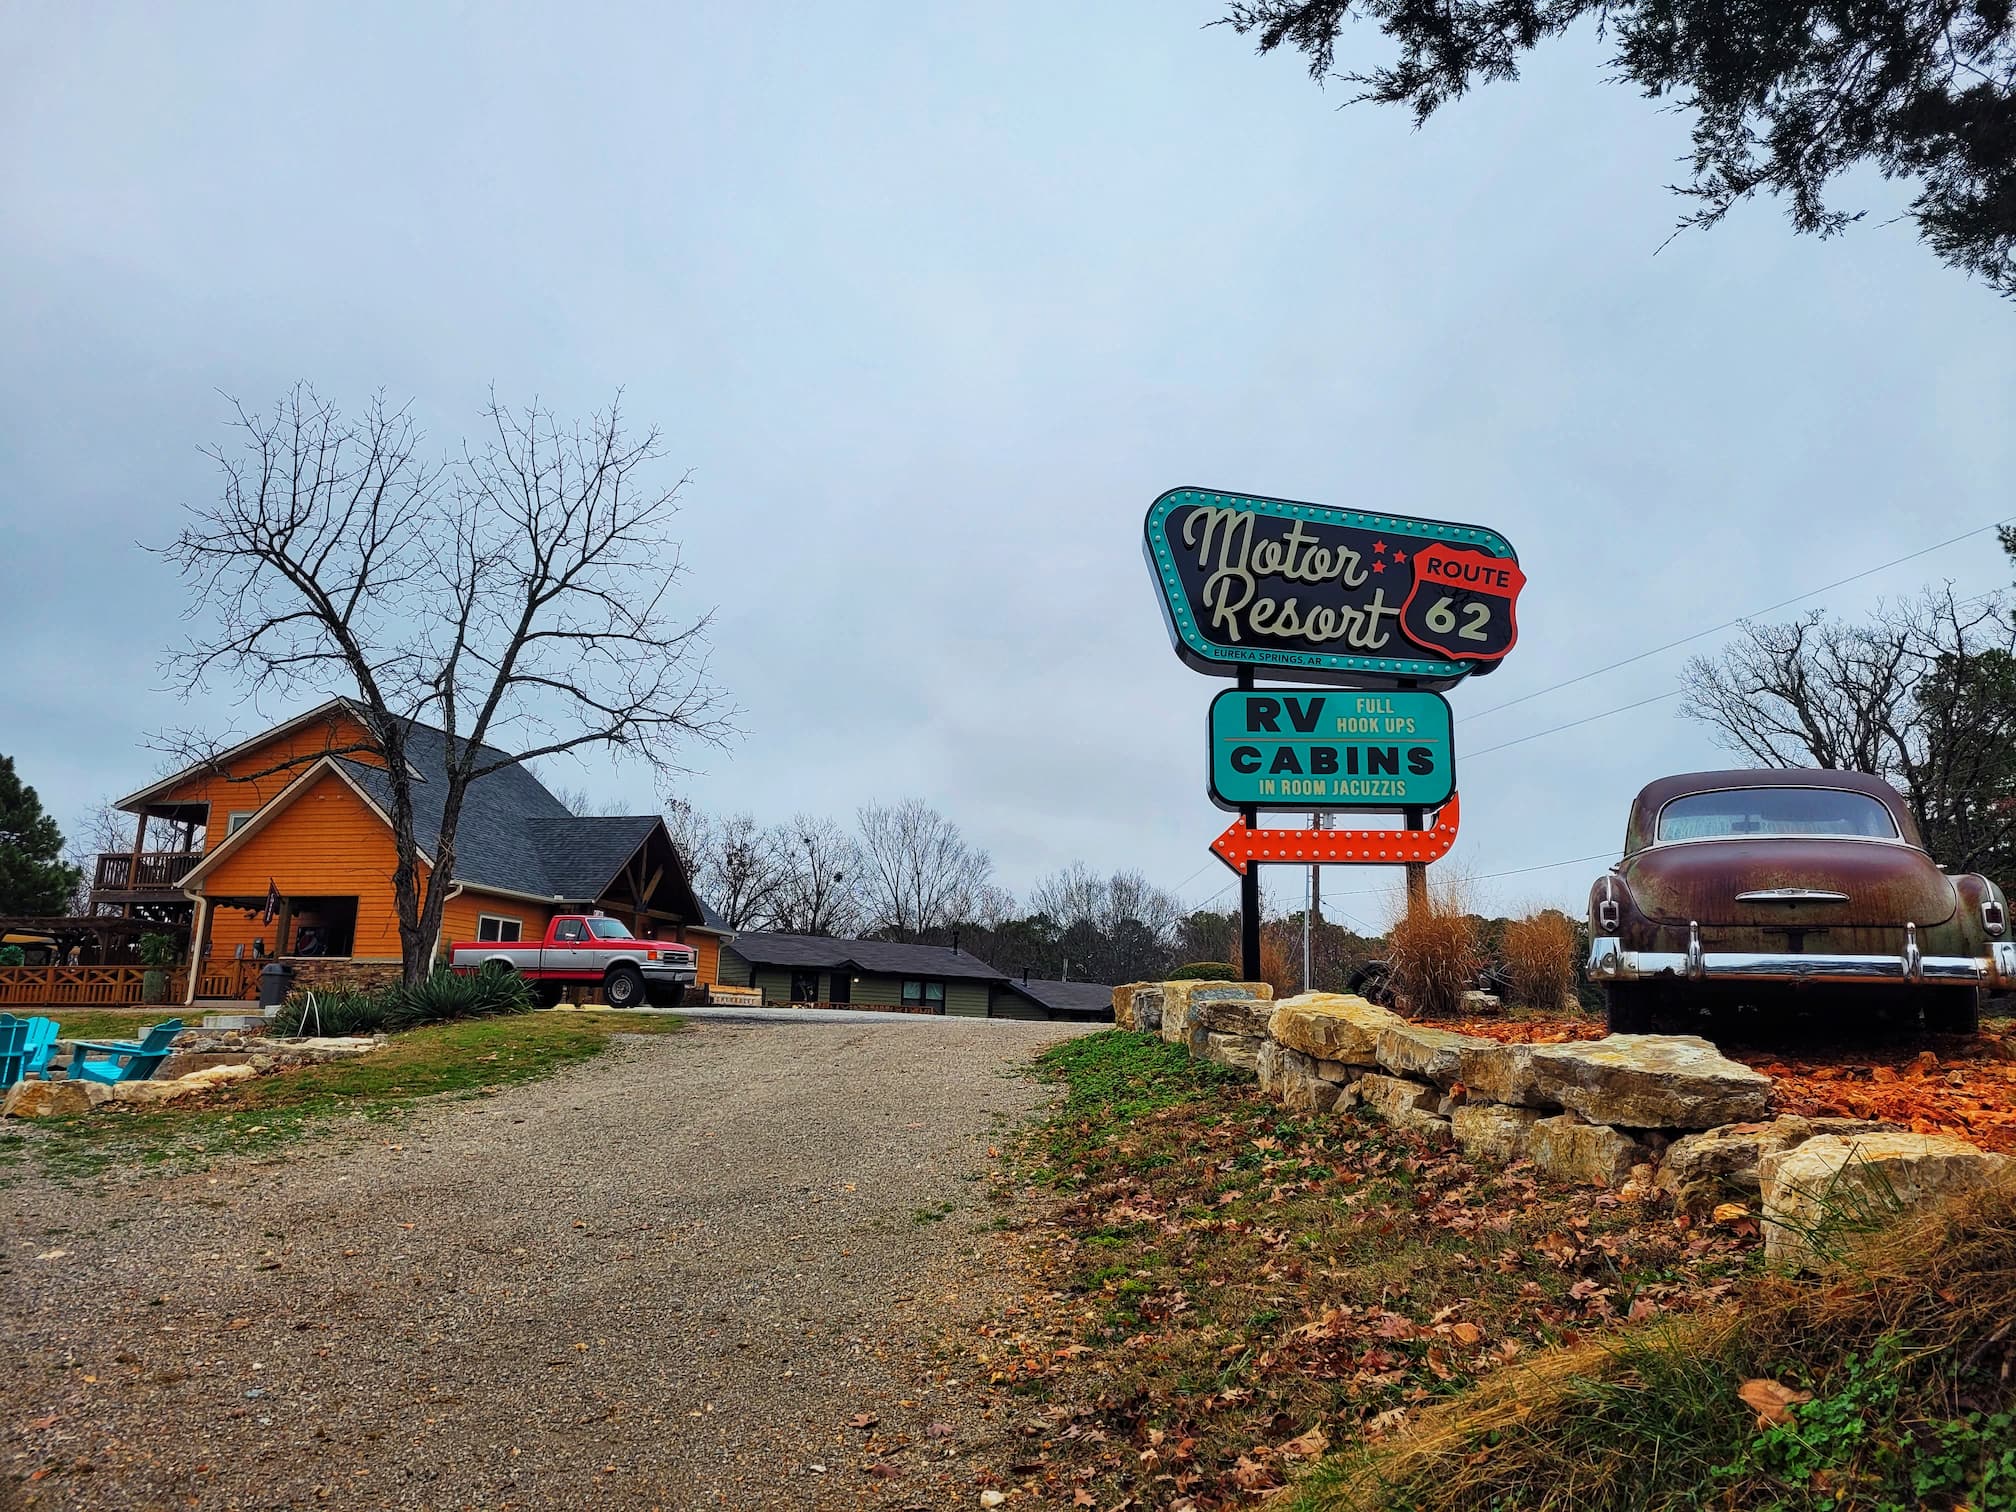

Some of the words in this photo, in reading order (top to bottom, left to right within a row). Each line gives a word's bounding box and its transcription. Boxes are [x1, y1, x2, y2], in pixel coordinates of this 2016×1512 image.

[1183, 507, 1369, 587] Motor
[1426, 559, 1511, 588] ROUTE
[1203, 569, 1401, 650] Resort
[1425, 597, 1492, 642] 62
[1214, 648, 1256, 660] EUREKA
[1259, 652, 1306, 665] SPRINGS,
[1307, 657, 1322, 665] AR
[1246, 697, 1326, 733] RV
[1356, 698, 1395, 714] FULL
[1337, 717, 1379, 733] HOOK
[1385, 718, 1416, 734] UPS
[1230, 745, 1434, 776] CABINS
[1259, 779, 1275, 795] IN
[1281, 779, 1326, 796] ROOM
[1332, 780, 1406, 797] JACUZZIS
